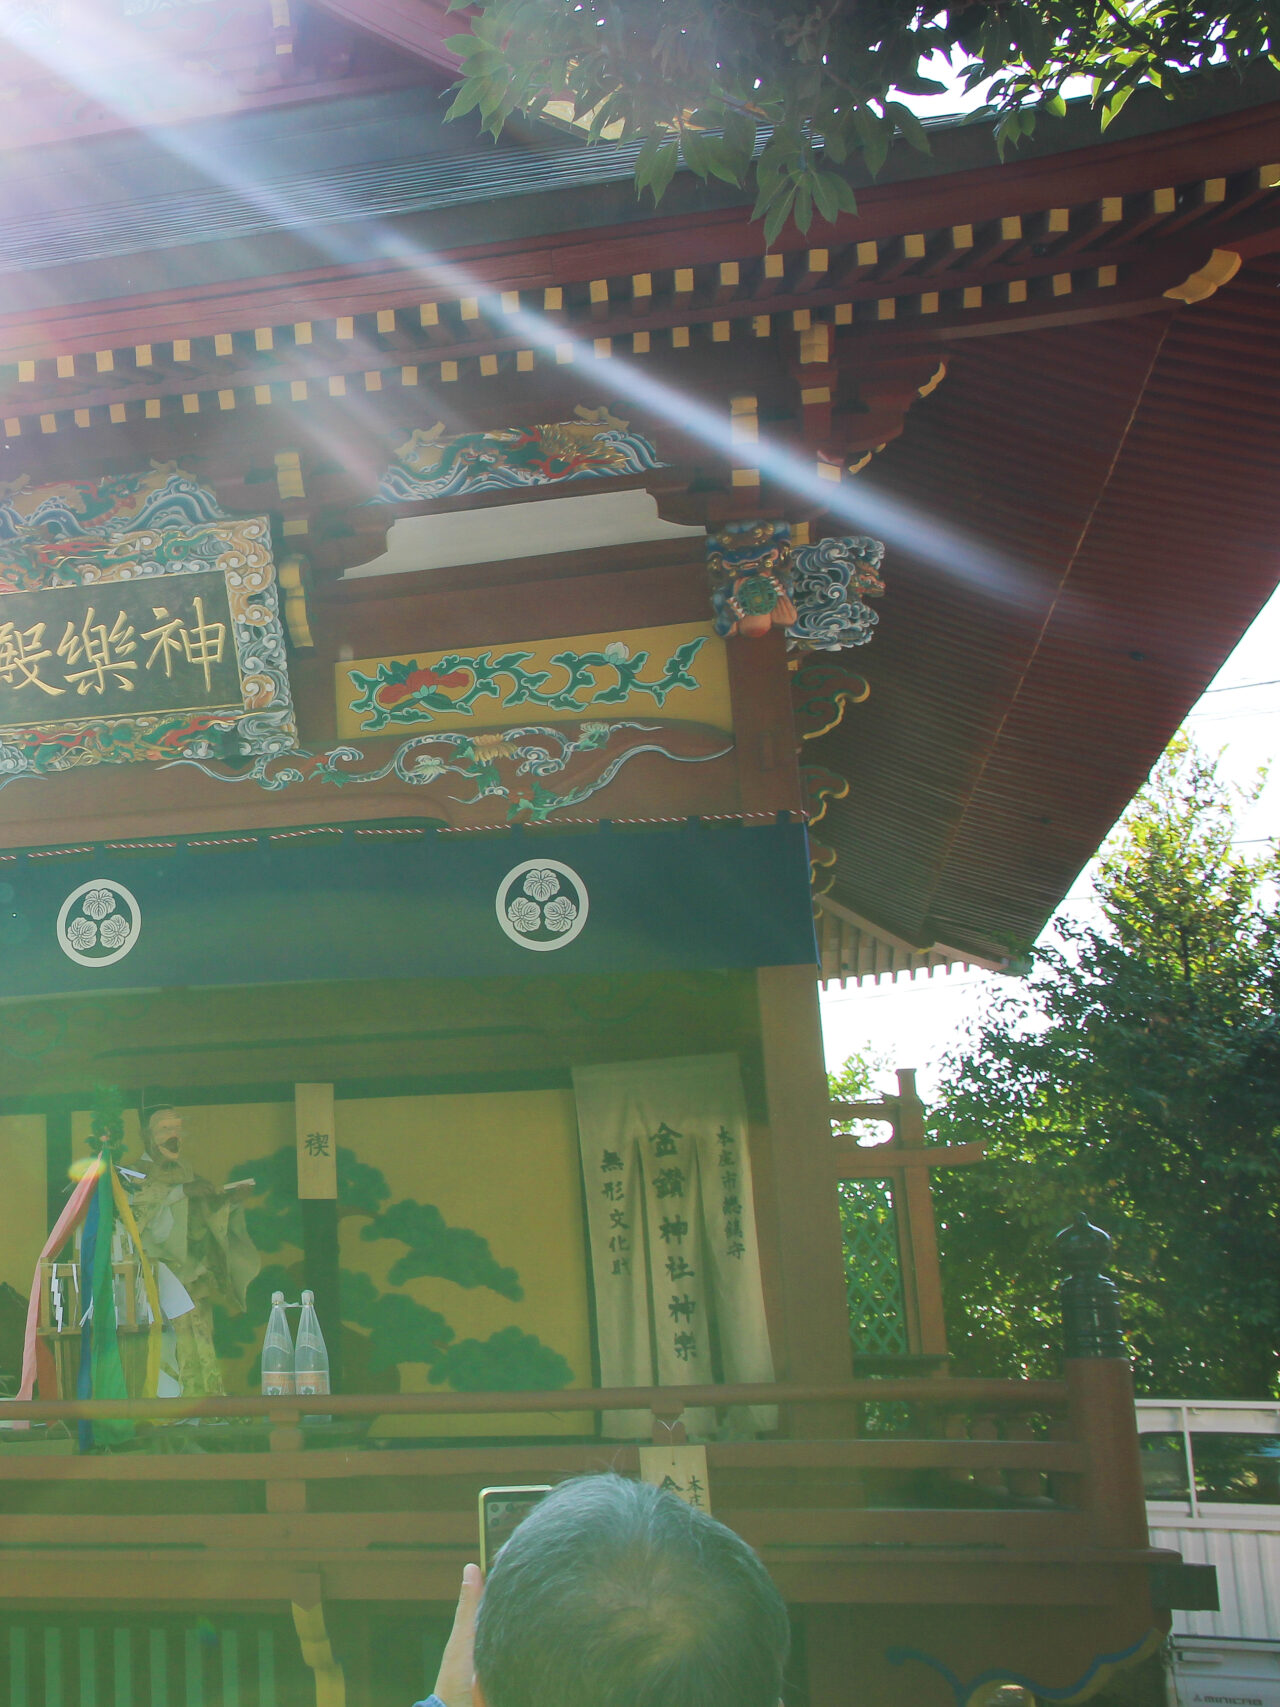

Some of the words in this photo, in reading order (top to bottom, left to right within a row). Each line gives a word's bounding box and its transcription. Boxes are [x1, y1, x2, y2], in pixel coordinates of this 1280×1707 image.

[600, 1149, 631, 1277] 無形文化財
